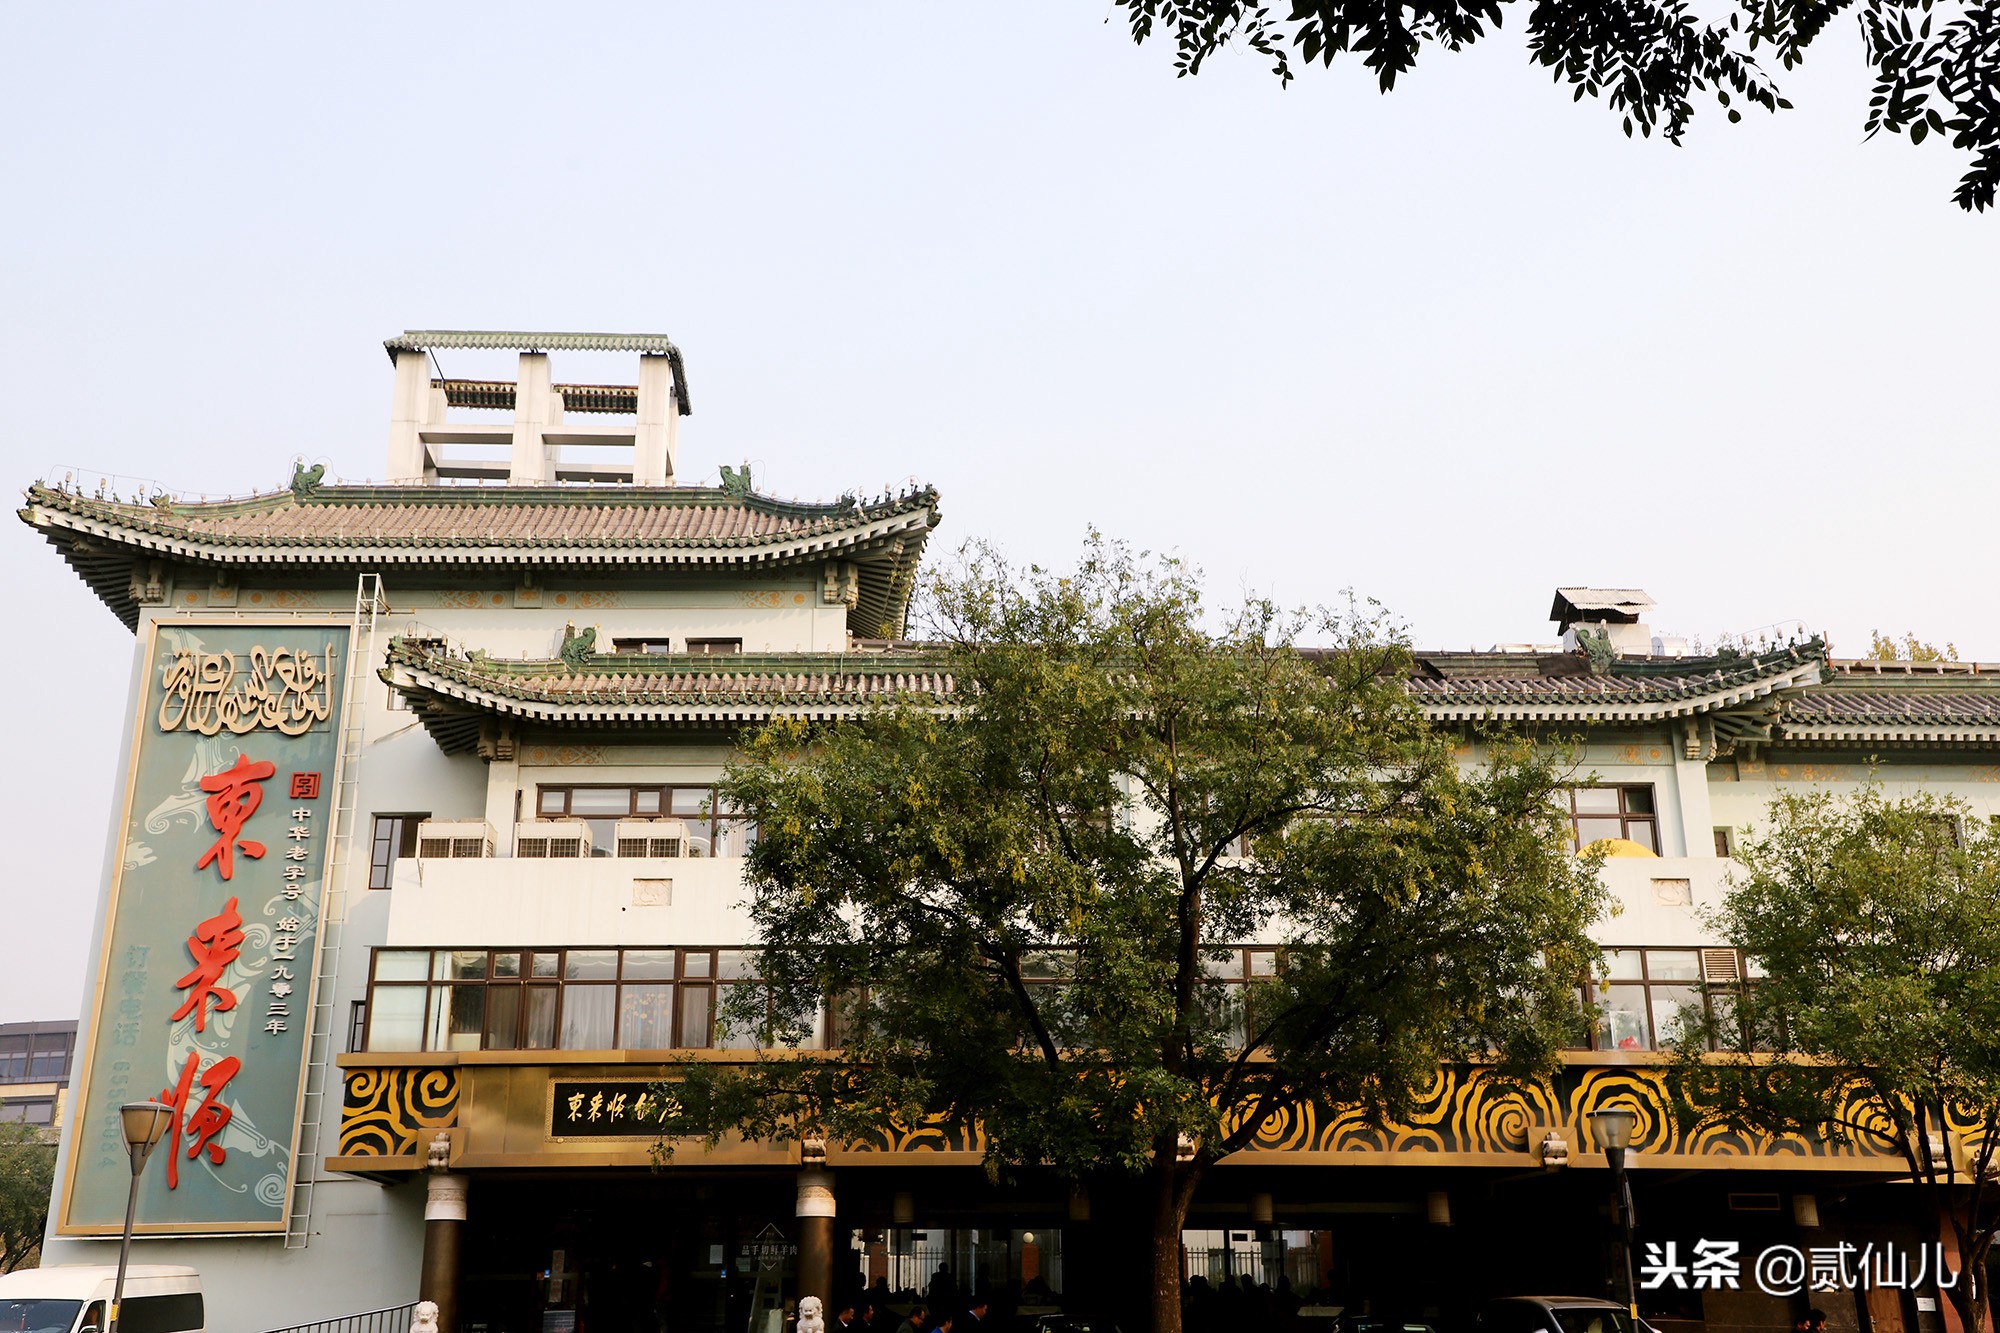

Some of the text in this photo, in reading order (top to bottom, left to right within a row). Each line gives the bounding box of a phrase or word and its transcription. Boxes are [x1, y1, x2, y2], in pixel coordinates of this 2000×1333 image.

[281, 807, 312, 900] 中华老字号
[264, 917, 300, 1036] 始于一九零三年
